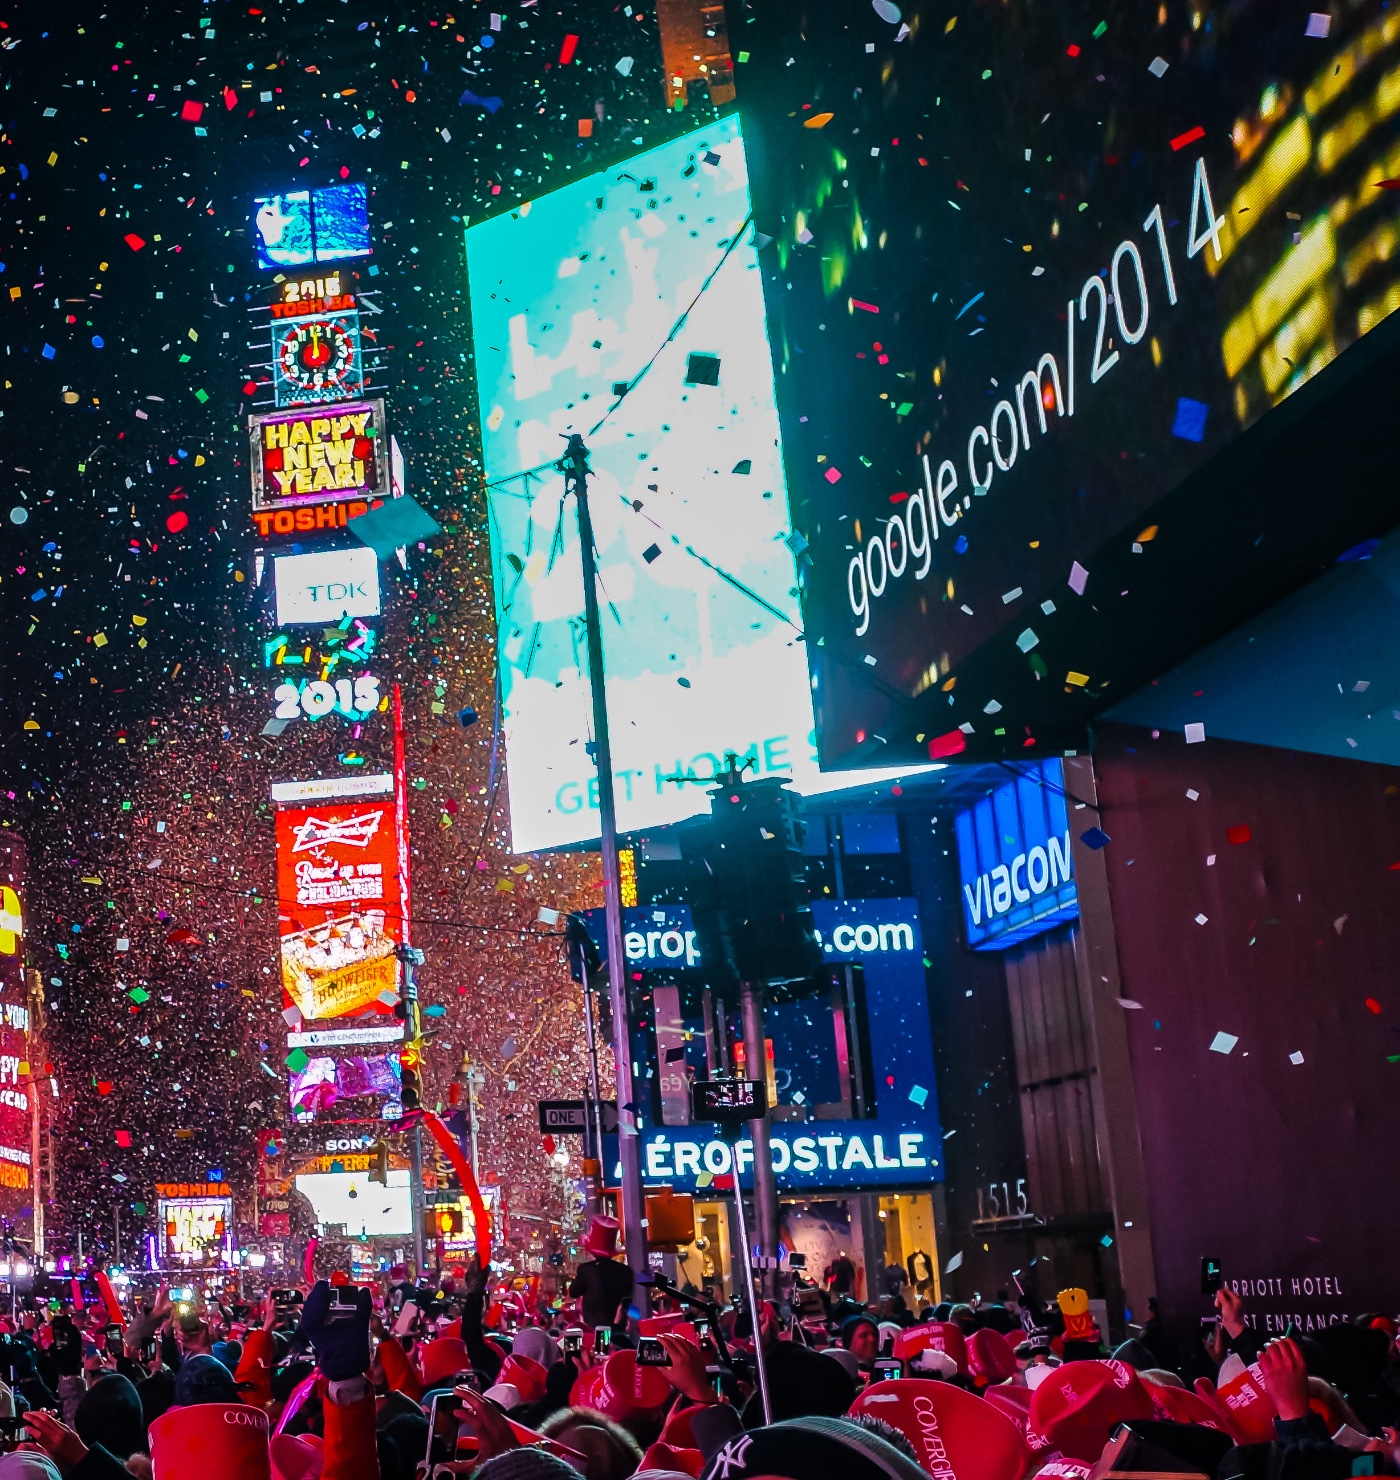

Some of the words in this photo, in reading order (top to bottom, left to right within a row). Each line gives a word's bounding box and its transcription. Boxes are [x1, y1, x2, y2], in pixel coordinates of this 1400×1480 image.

[271, 294, 356, 318] TOSHBA
[848, 157, 1225, 637] google.com/2014
[265, 412, 371, 449] HAPPY
[283, 438, 356, 471] NEW
[273, 460, 365, 495] YEAR!
[306, 580, 369, 602] TDK
[274, 675, 380, 720] 2015
[555, 769, 637, 815] GET
[654, 734, 793, 796] HOME
[549, 1109, 576, 1124] ONE
[325, 1137, 375, 1151] SONY
[614, 1134, 927, 1178] ÉROPOSTALE
[155, 1183, 231, 1197] TOSHIBA
[977, 1178, 1028, 1221] 1515
[1222, 1278, 1283, 1297] ARRIOTT
[1291, 1276, 1343, 1296] HOTEL
